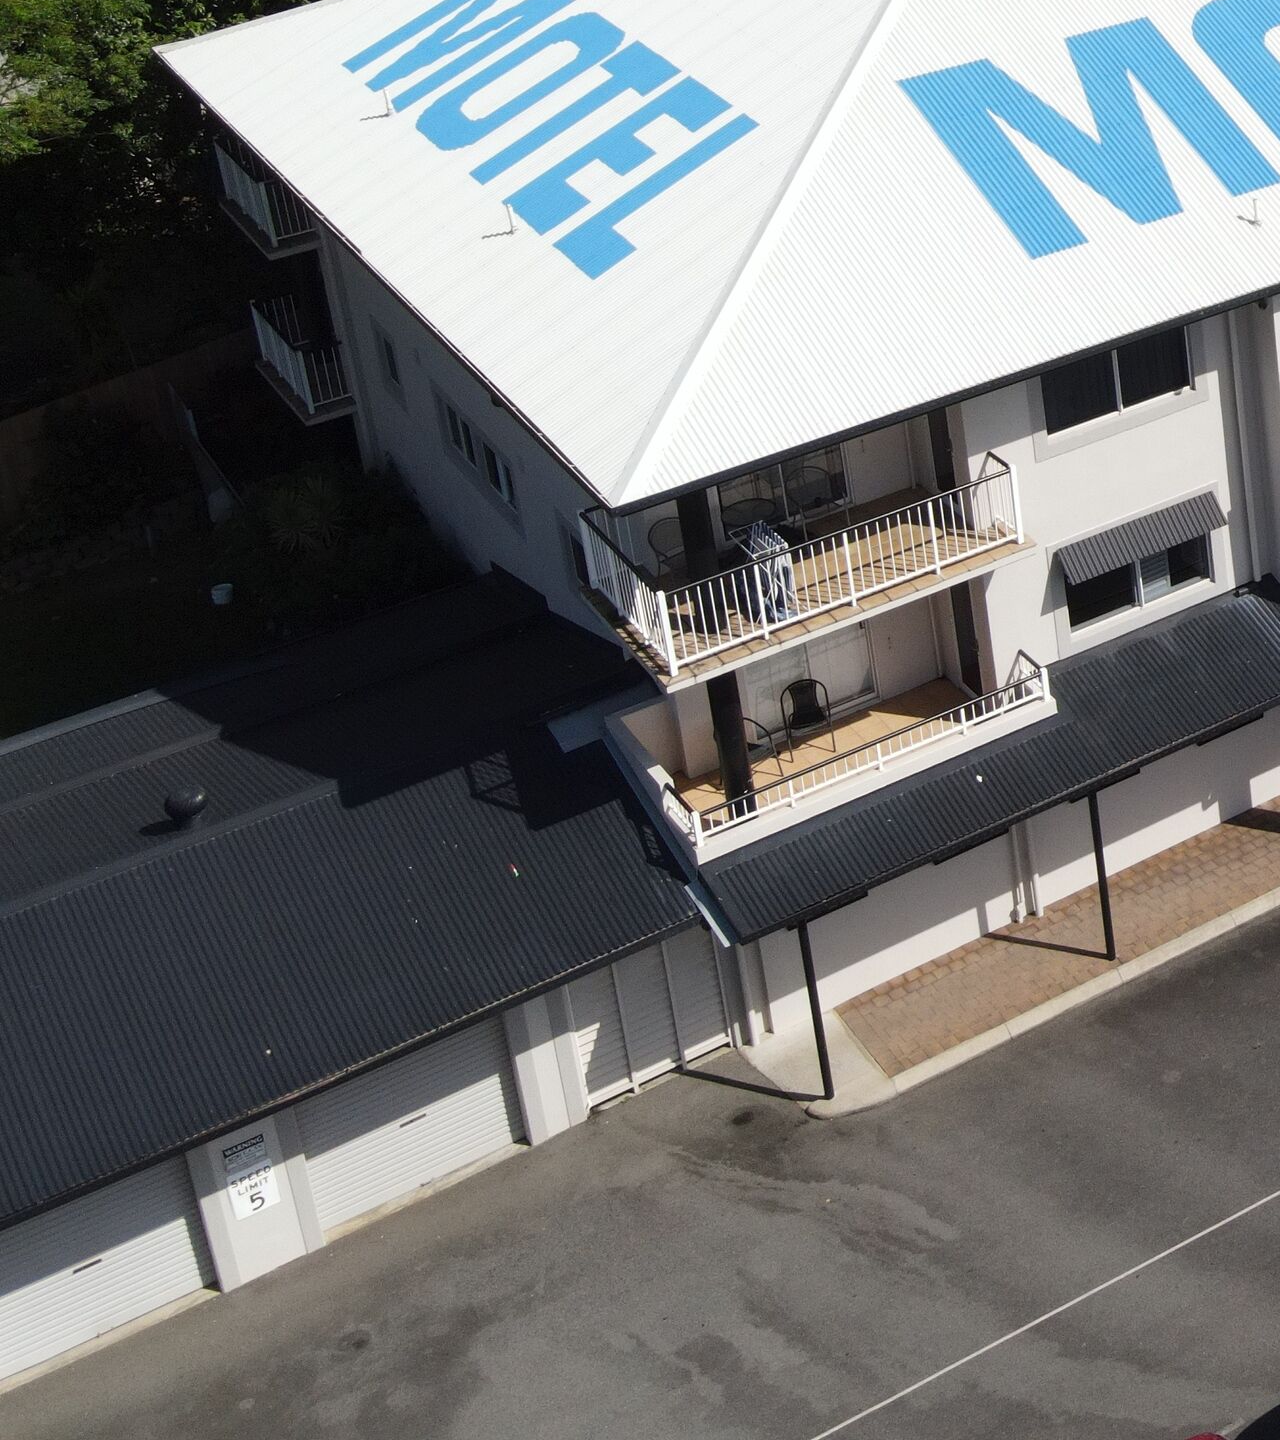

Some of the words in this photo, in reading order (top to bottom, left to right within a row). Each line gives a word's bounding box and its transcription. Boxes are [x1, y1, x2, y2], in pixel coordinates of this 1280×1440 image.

[231, 1165, 271, 1188] SPEED
[238, 1177, 269, 1196] LIMIT
[249, 1191, 265, 1212] 5
